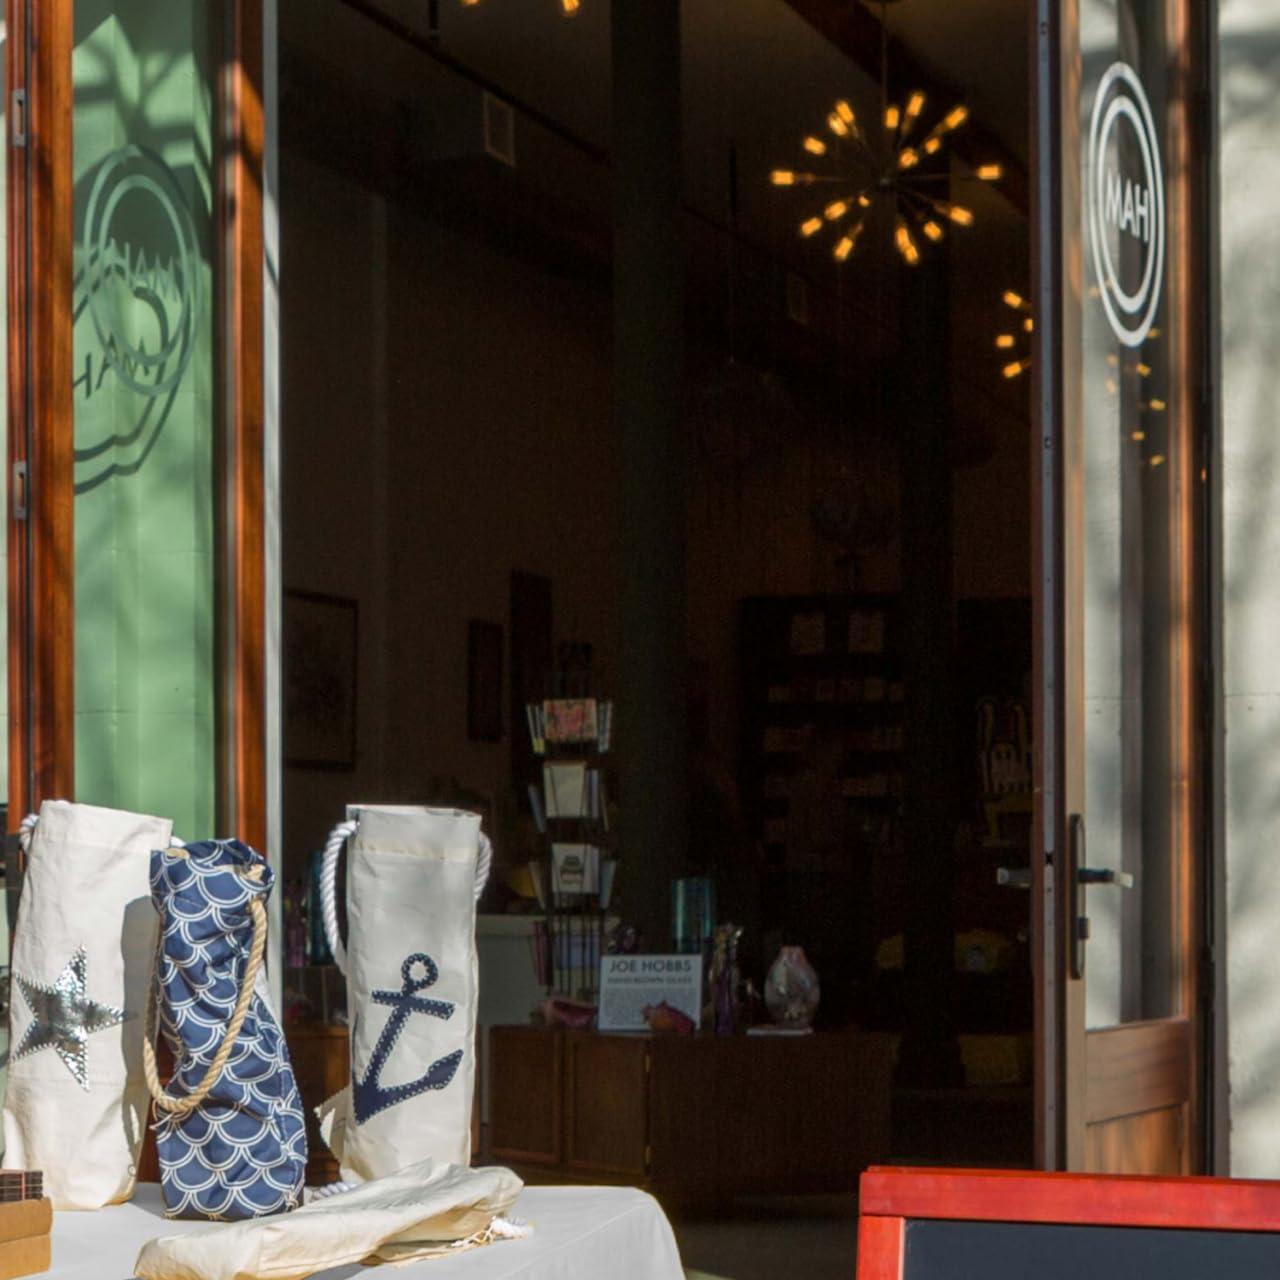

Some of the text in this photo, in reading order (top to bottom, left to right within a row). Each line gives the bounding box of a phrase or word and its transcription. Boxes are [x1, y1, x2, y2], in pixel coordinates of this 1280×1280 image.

[1105, 169, 1149, 243] MAH
[609, 960, 693, 974] JOE HOBBS
